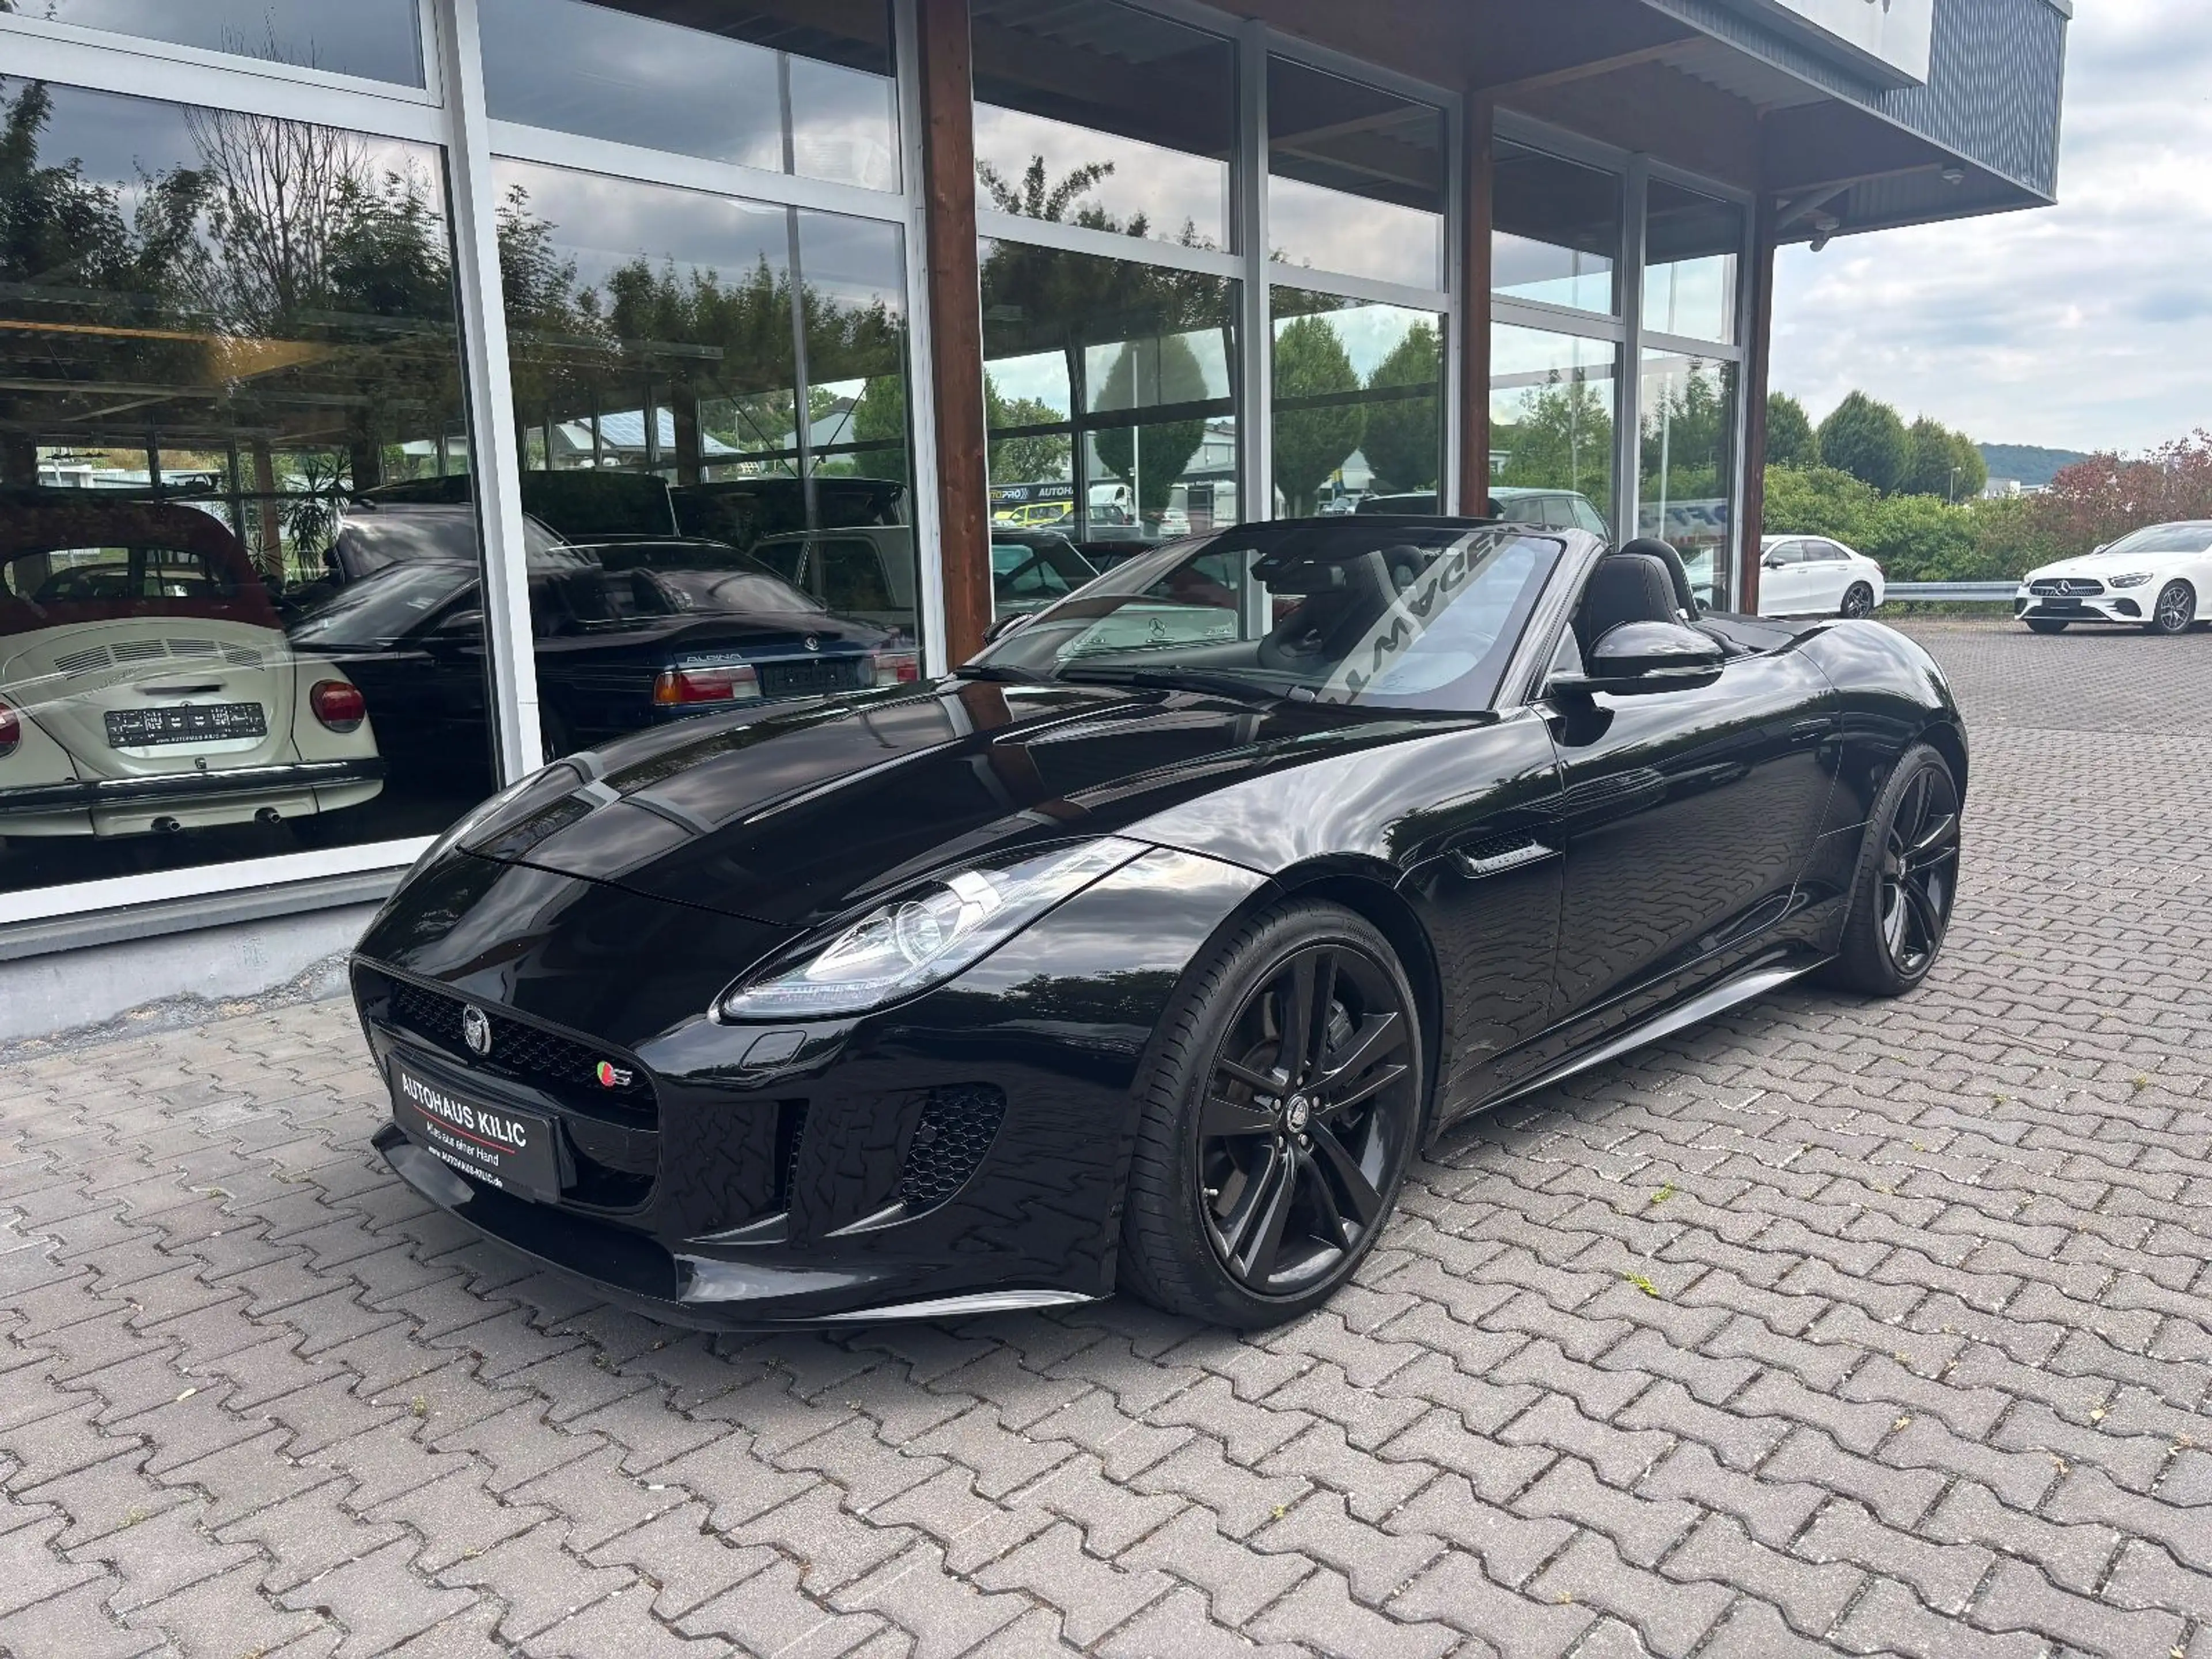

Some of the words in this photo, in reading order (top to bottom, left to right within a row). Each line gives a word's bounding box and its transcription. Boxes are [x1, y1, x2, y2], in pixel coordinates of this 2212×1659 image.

[402, 1073, 475, 1129] AUTOHAUS
[477, 1111, 527, 1147] KILIC
[476, 1146, 499, 1166] Hand
